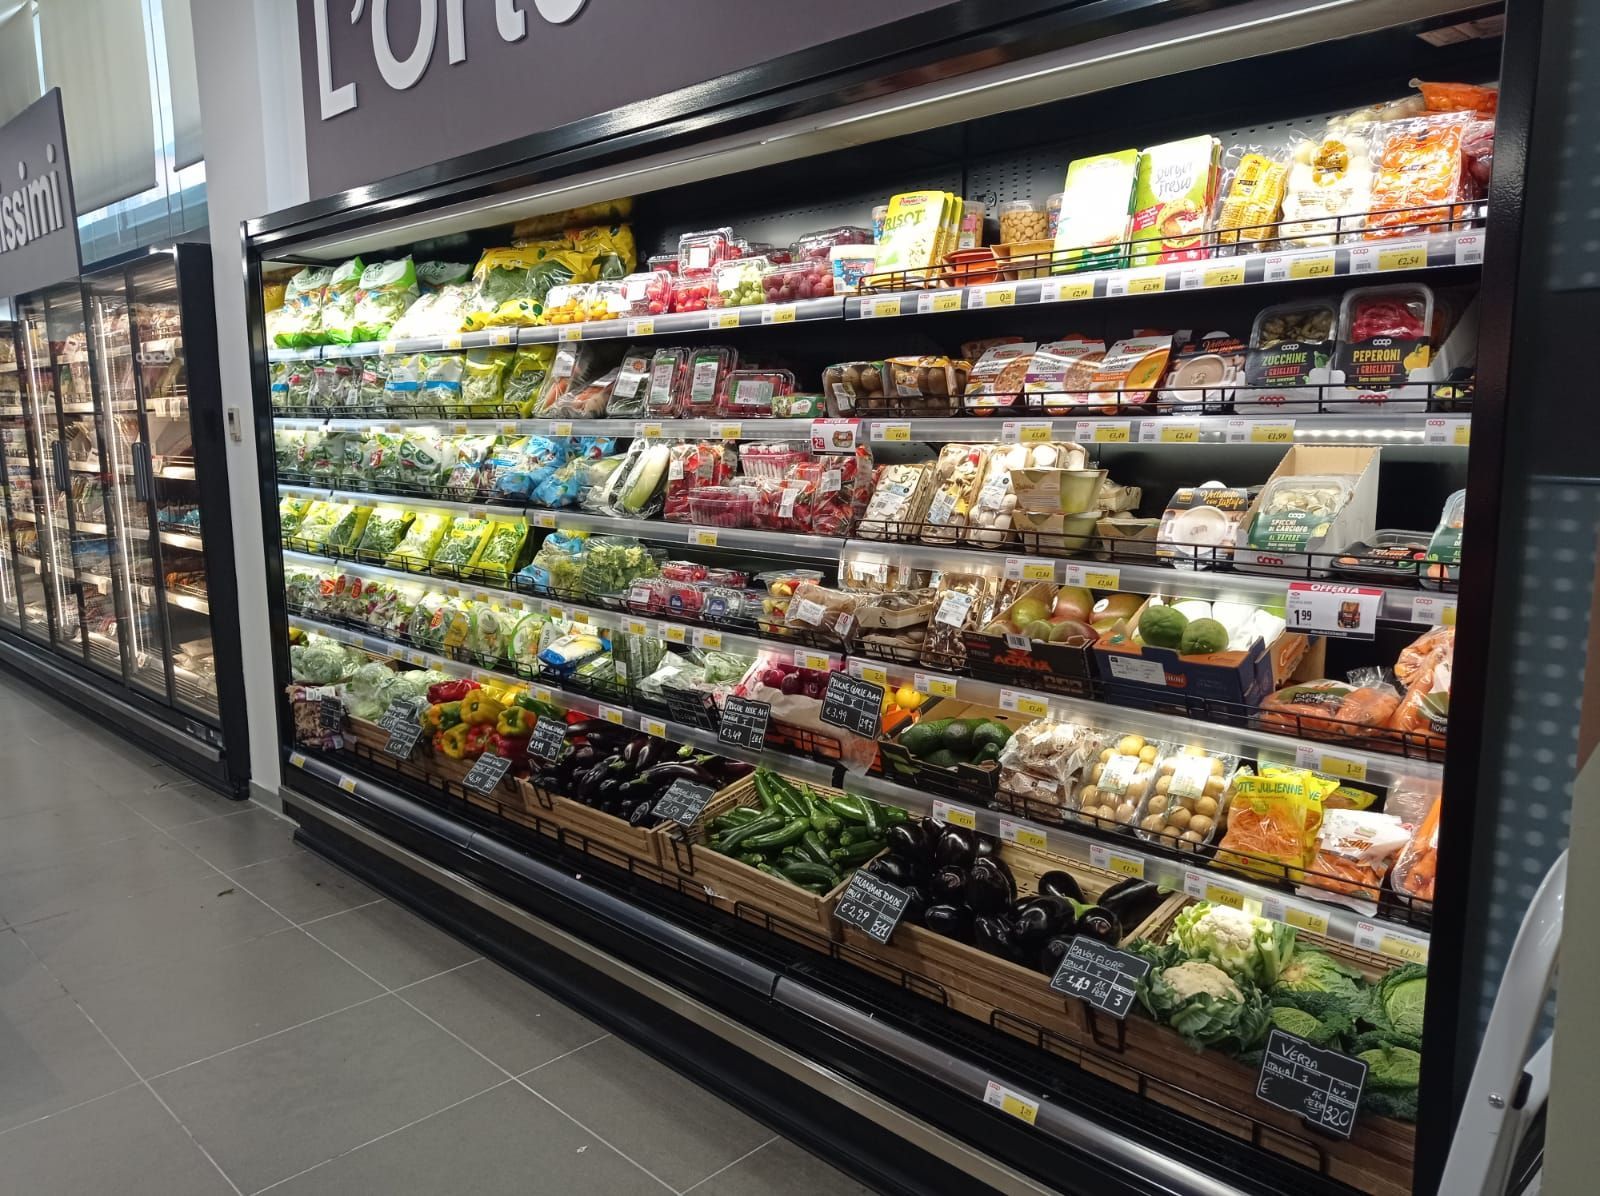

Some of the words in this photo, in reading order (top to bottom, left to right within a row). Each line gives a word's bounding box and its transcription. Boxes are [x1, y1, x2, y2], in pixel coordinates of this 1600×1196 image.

[1458, 236, 1477, 245] coop
[1281, 343, 1300, 351] coop
[1372, 338, 1392, 347] coop
[1262, 352, 1308, 367] ZUCCHINE
[1353, 348, 1401, 363] PEPERONI
[1267, 432, 1287, 441] €1,99
[1310, 583, 1360, 594] OFFERTA
[1258, 782, 1304, 796] JULIENNE
[1113, 994, 1124, 1007] 3
[1281, 1042, 1319, 1070] VERZA
[1323, 1105, 1351, 1127] 320
